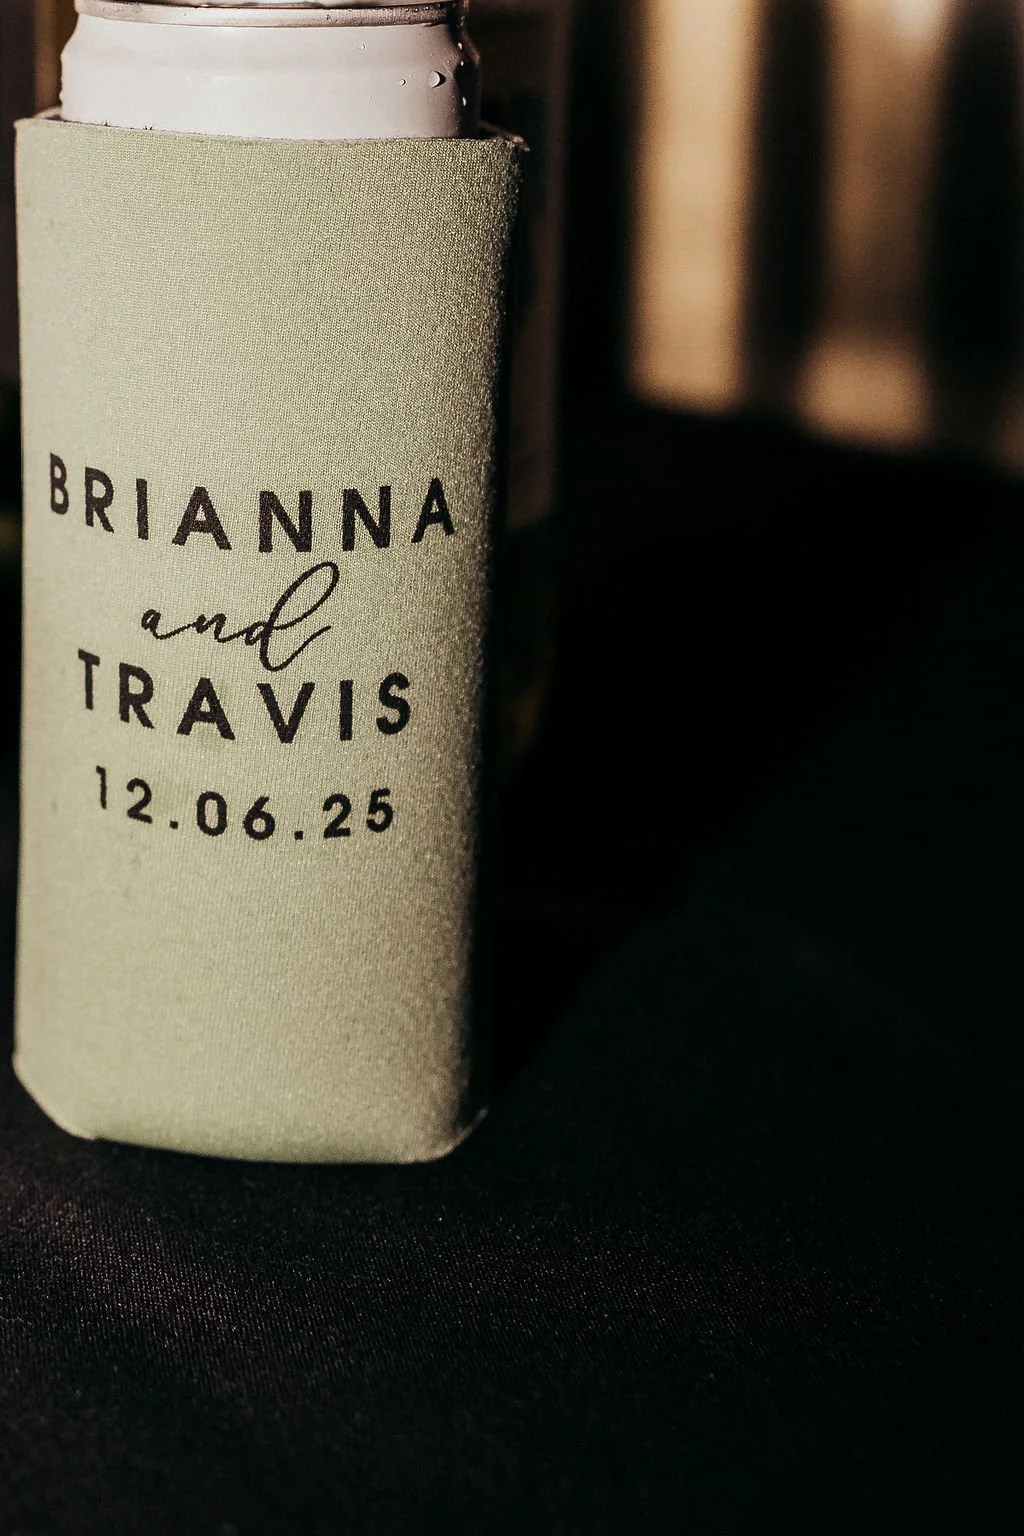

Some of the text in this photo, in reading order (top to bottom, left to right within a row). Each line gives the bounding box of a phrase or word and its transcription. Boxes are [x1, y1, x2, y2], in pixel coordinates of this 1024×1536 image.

[49, 452, 456, 553] BRIANNA
[141, 561, 340, 672] and
[78, 648, 412, 744] TRAVIS
[96, 765, 395, 841] 12.06.25
